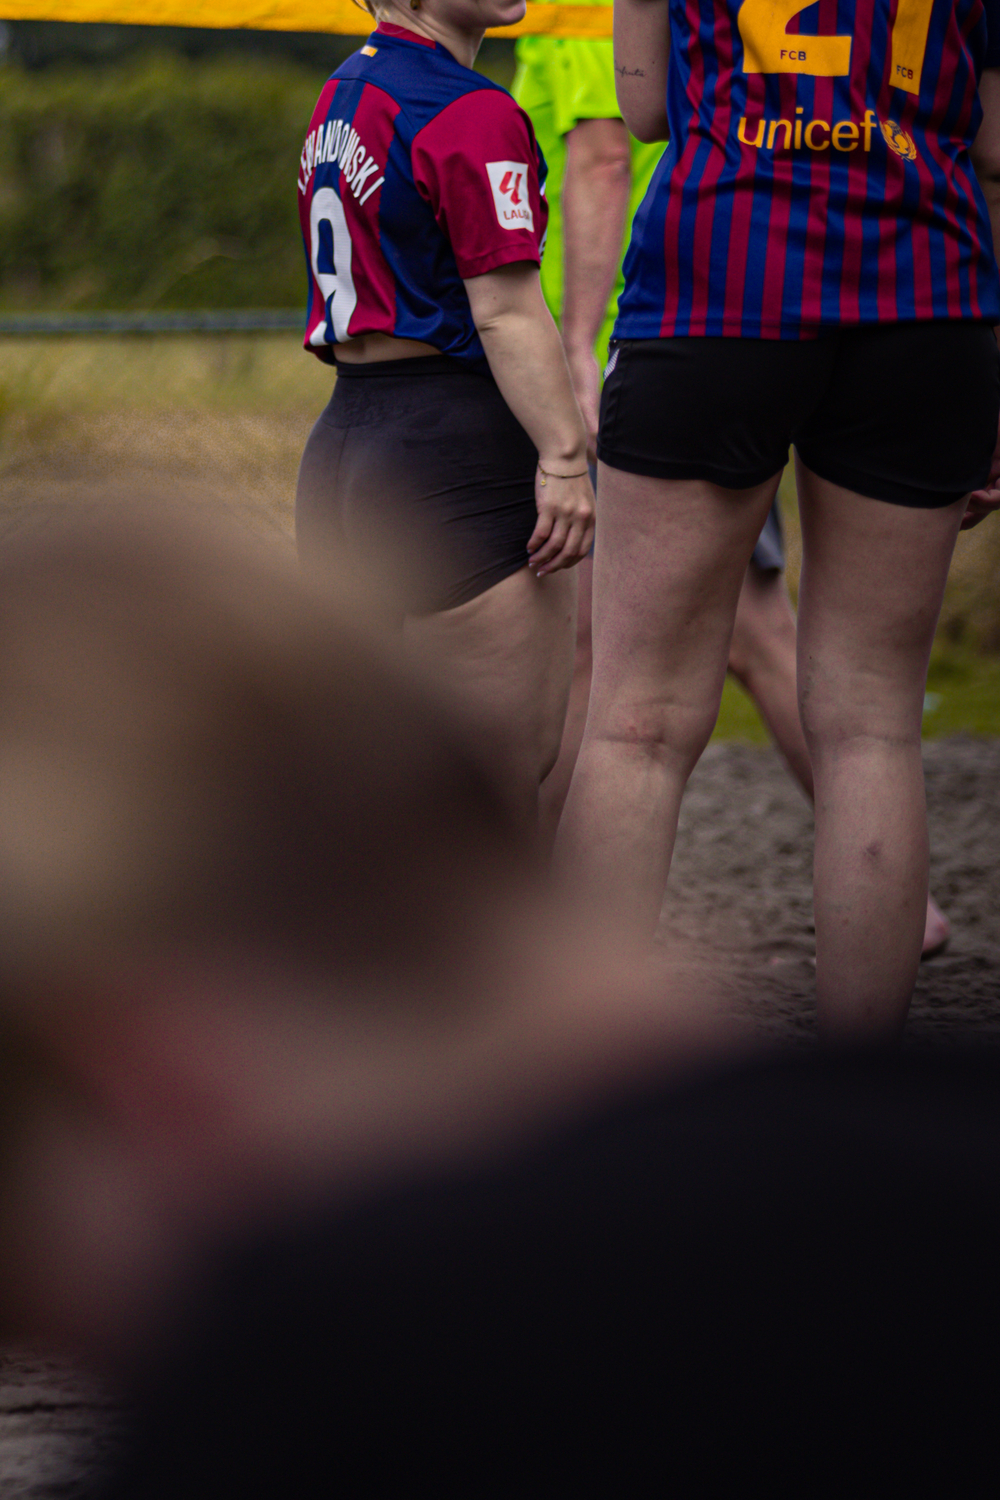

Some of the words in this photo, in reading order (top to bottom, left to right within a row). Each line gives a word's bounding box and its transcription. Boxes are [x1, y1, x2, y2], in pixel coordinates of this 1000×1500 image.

[780, 49, 807, 61] FCB
[896, 65, 914, 80] FCB
[737, 107, 877, 152] unicef
[309, 186, 357, 346] 9
